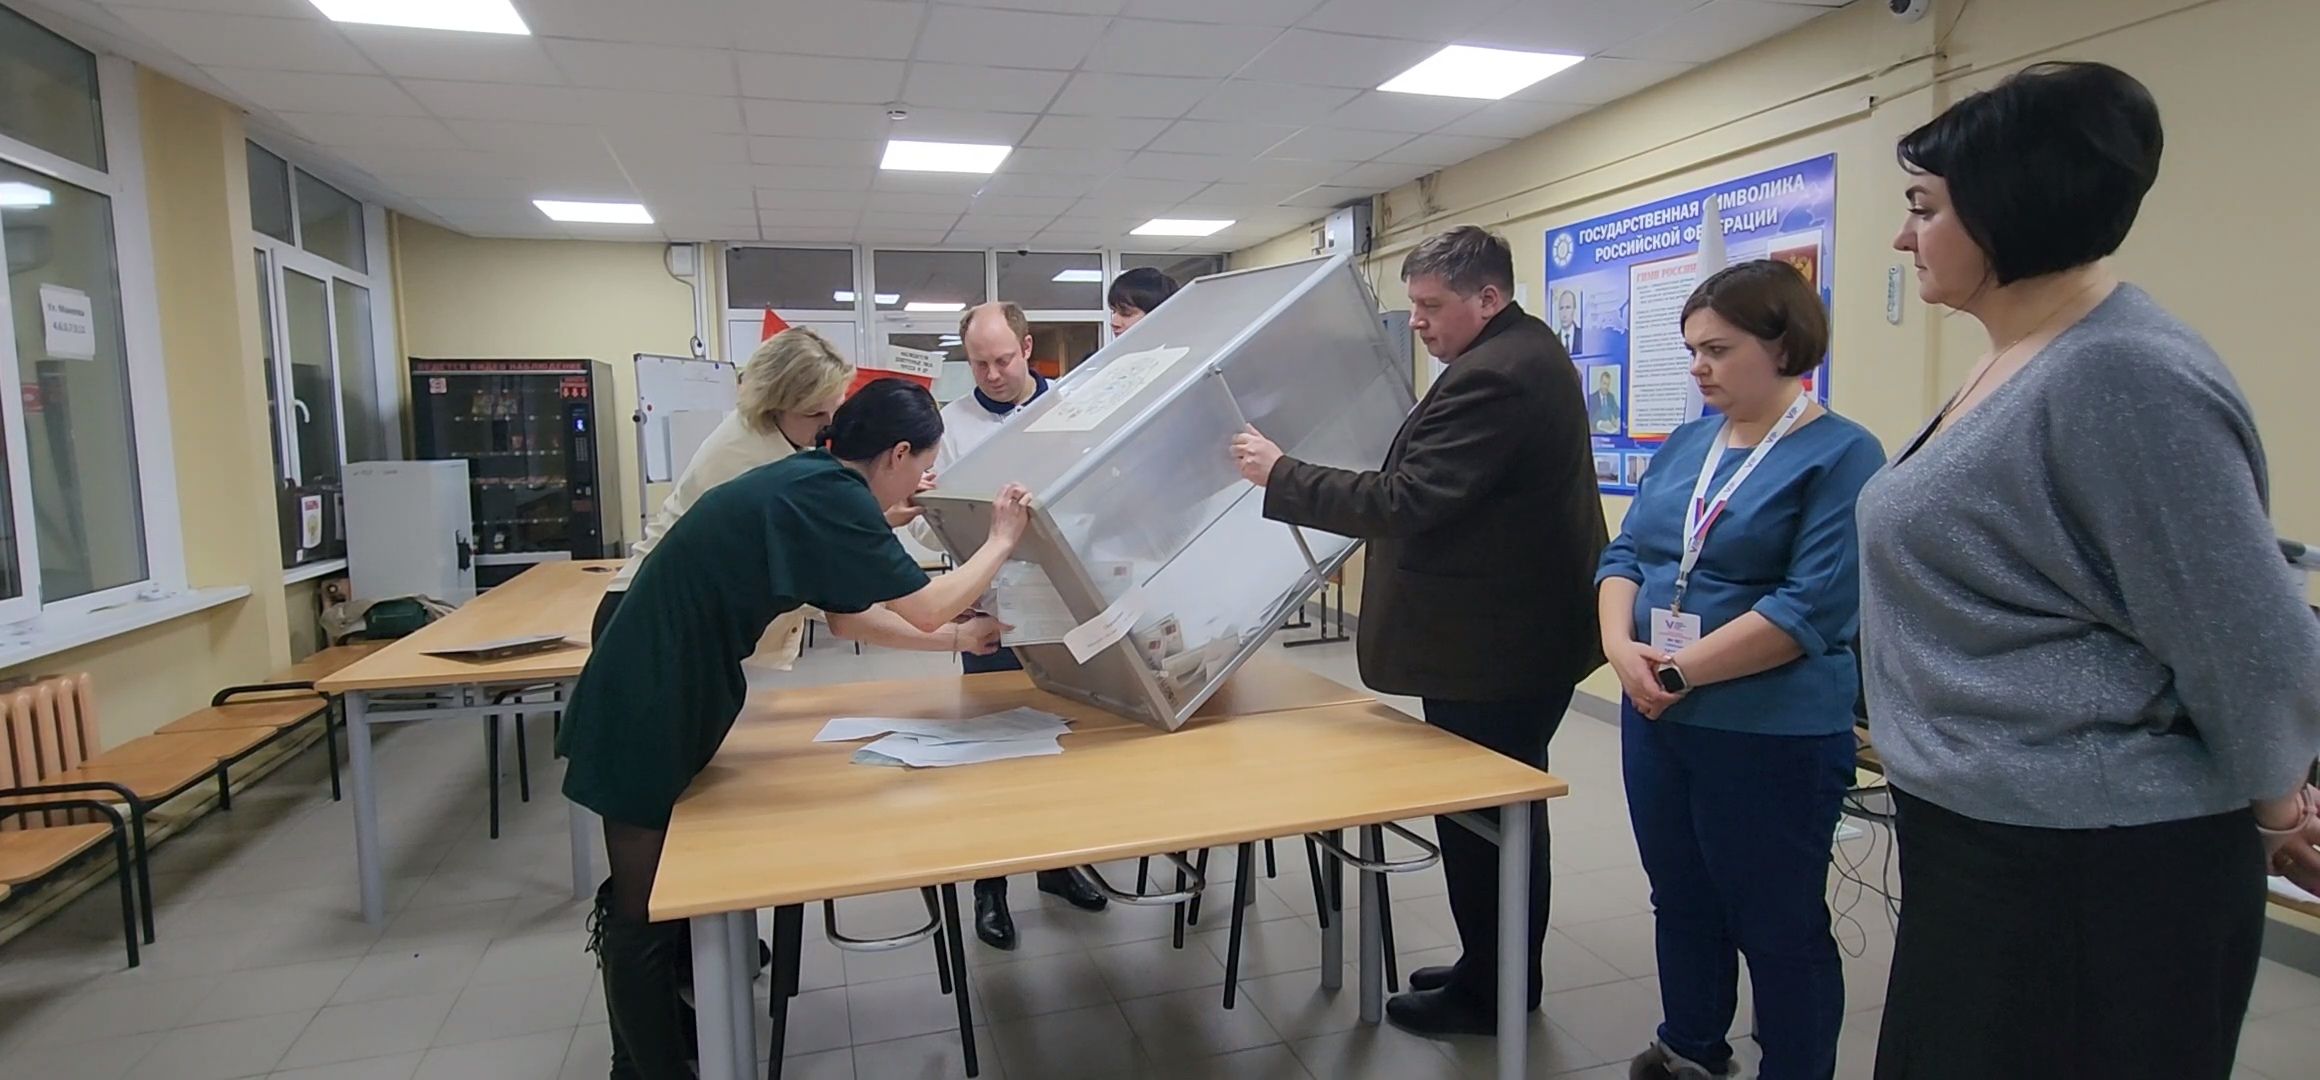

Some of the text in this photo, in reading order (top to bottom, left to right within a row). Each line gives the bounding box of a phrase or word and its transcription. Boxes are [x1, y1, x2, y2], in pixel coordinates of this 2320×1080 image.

[1579, 201, 1699, 244] ГОСУДАРСТВЕННАЯ
[1595, 207, 1778, 262] РОССИЙСКОЙ ФЕРАЦИИ
